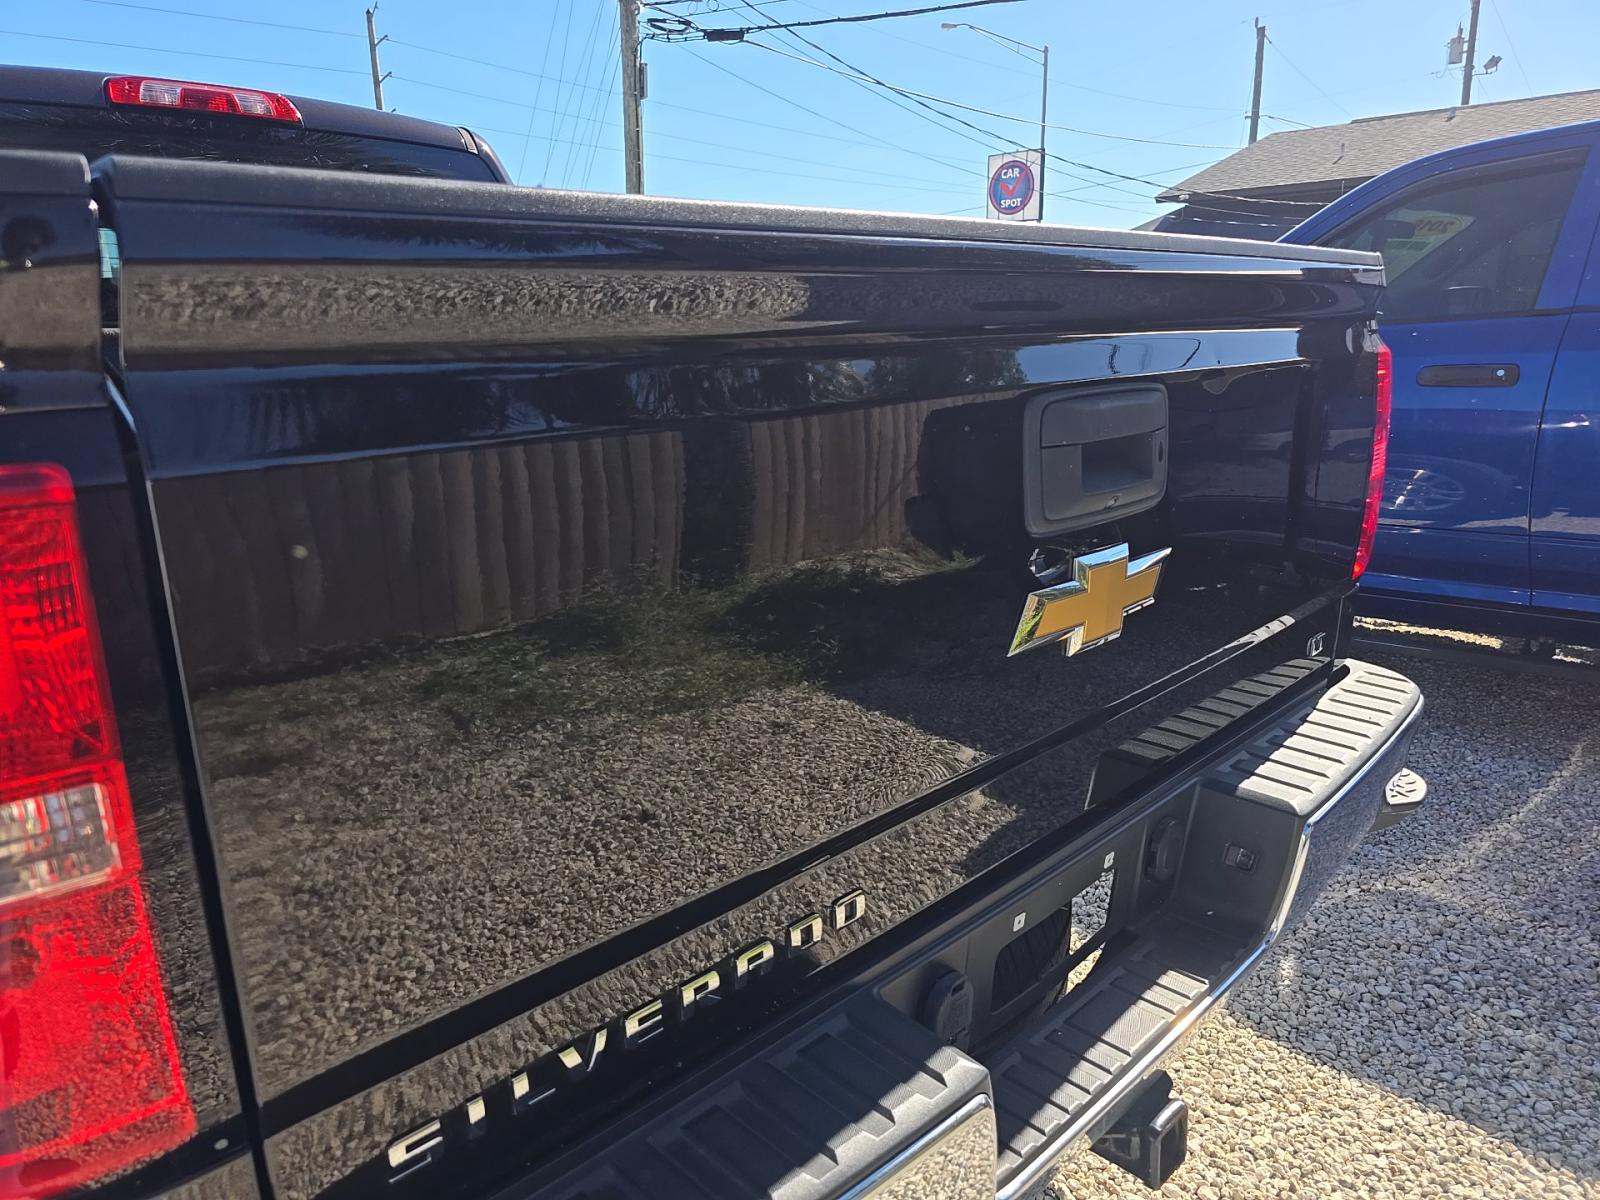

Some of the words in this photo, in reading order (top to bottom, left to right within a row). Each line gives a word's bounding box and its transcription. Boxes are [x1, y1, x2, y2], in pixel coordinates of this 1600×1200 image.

[1001, 167, 1020, 179] CAR
[1000, 198, 1022, 208] SPOT
[387, 888, 867, 1184] SILVERADO
